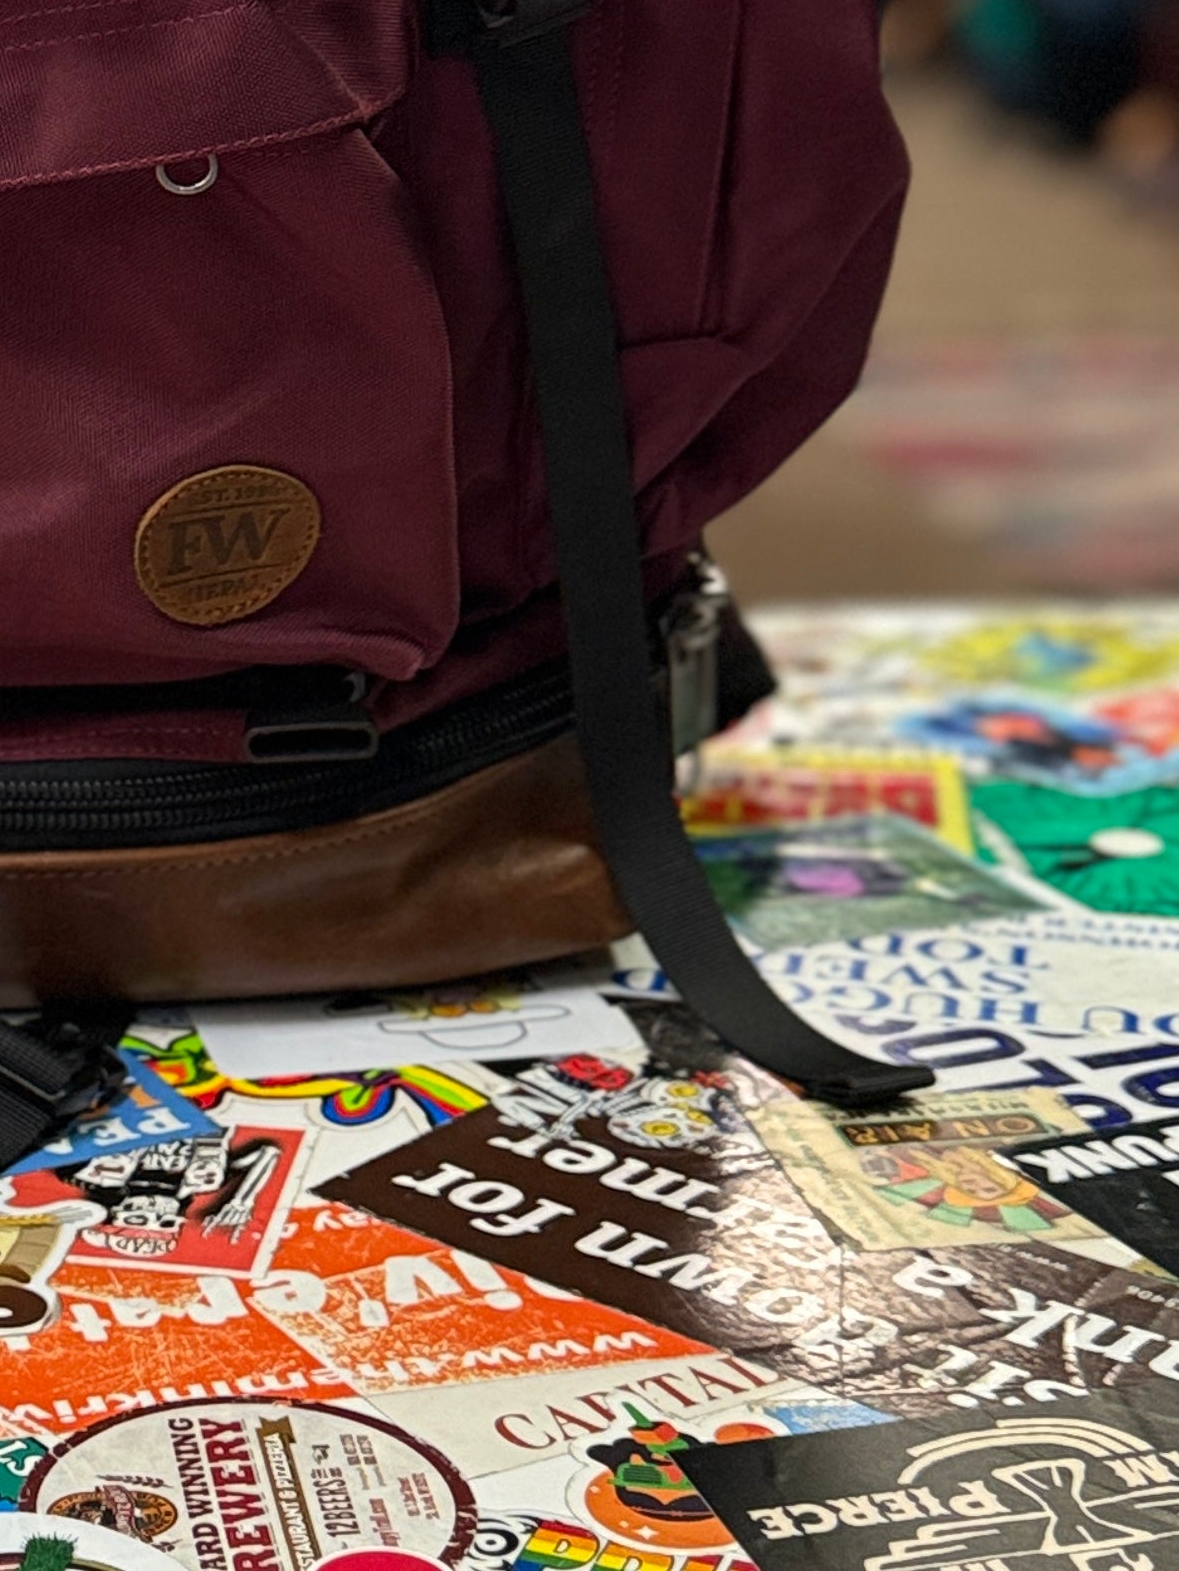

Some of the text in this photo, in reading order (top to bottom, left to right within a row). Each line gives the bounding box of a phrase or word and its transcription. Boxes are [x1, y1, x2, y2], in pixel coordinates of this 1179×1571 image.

[392, 1160, 575, 1237] for
[167, 1416, 215, 1520] WINNING
[746, 1479, 1014, 1541] PIERCE
